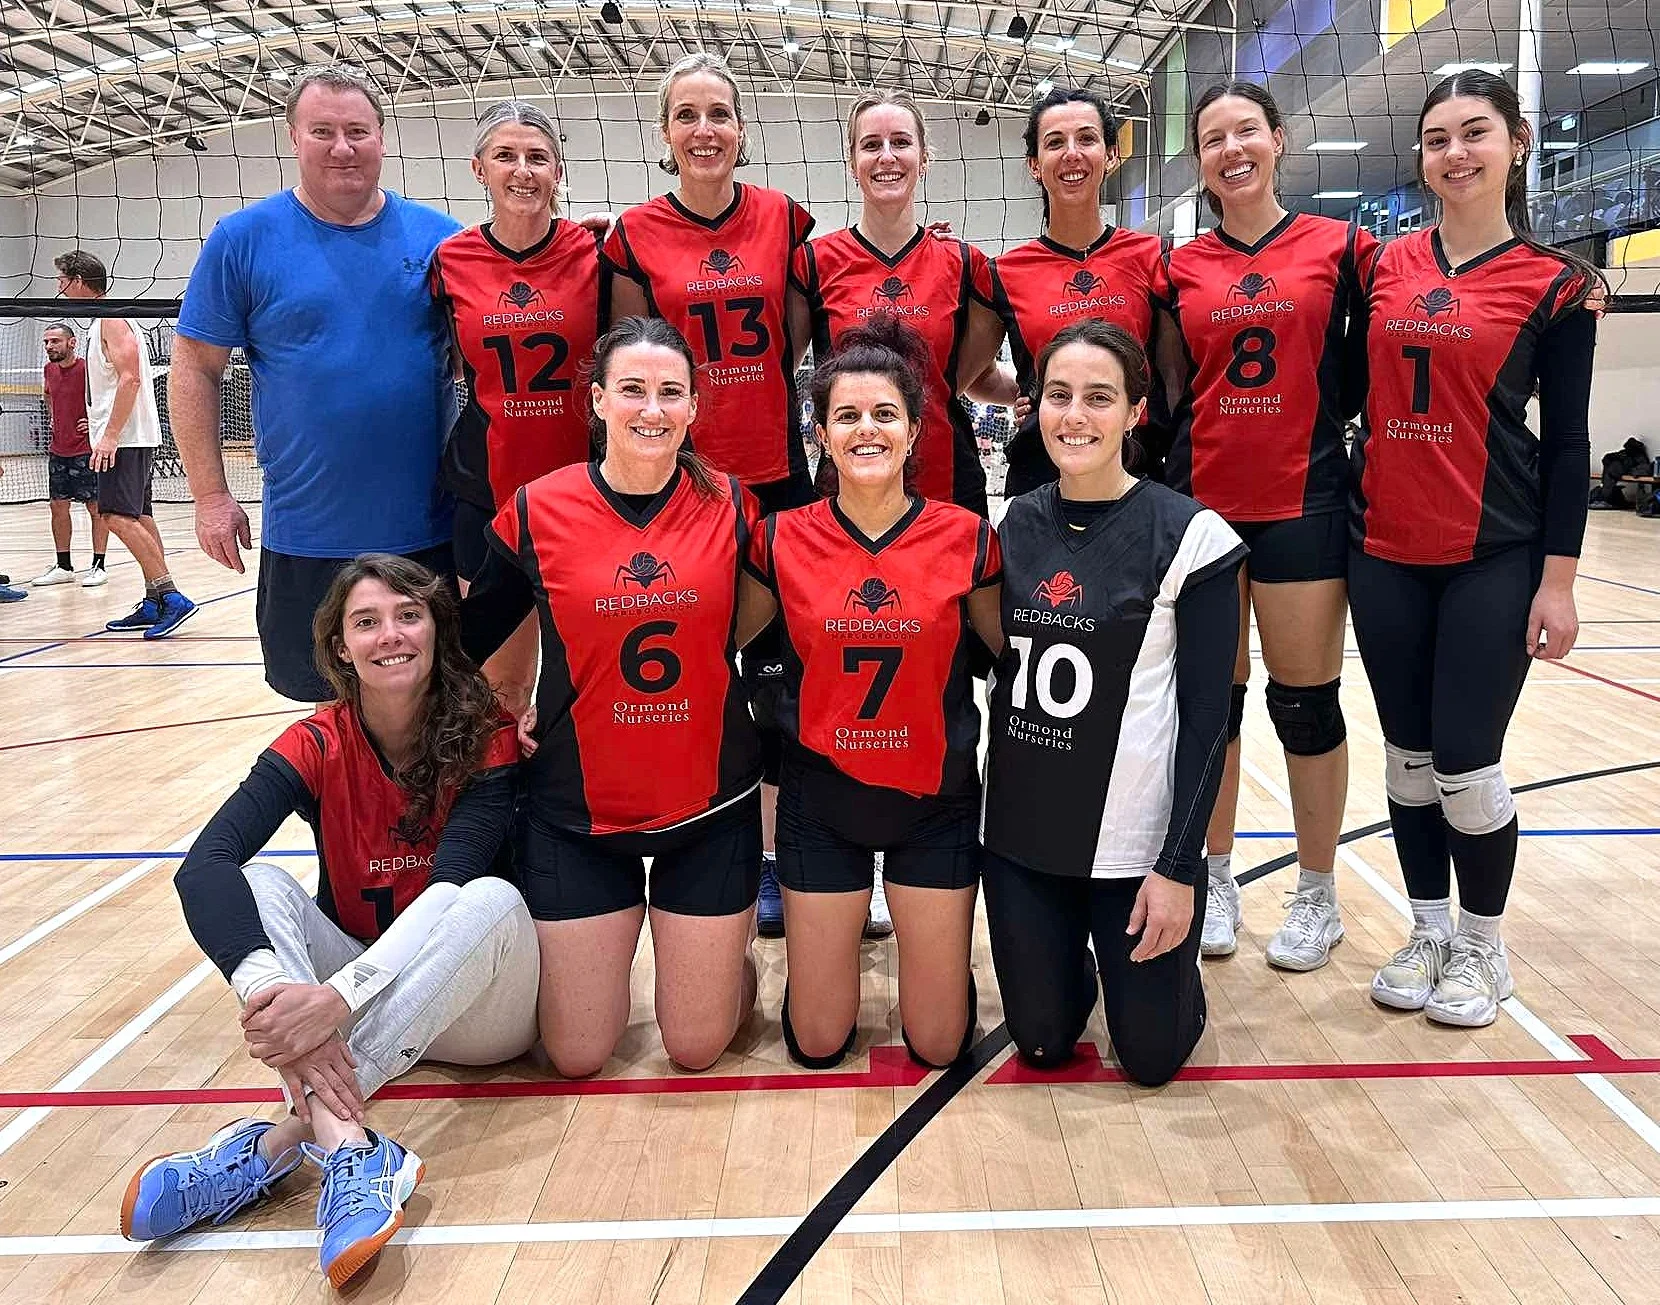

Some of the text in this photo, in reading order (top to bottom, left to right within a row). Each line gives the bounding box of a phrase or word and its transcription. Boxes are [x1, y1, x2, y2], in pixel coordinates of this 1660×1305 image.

[686, 275, 763, 292] REDBACKS
[1049, 295, 1126, 315] REDBACKS
[1211, 300, 1294, 322] REDBACKS
[483, 310, 565, 326] REDBACKS
[687, 297, 770, 363] 13
[1385, 319, 1473, 339] REDBACKS
[483, 333, 571, 394] 12
[1225, 326, 1276, 390] 8
[709, 363, 764, 377] Ormond
[709, 374, 764, 387] Nurseries
[1402, 345, 1431, 415] 1
[503, 396, 563, 409] Ormond
[1219, 393, 1281, 406] Ormond
[504, 406, 564, 418] Nurseries
[1219, 404, 1281, 415] Nurseries
[1386, 418, 1453, 433] Ormond
[1386, 428, 1453, 443] Nurseries
[595, 589, 699, 612] REDBACKS
[825, 619, 921, 633] REDBACKS
[1013, 608, 1096, 632] REDBACKS
[619, 620, 682, 694] 6
[842, 645, 904, 721] 7
[1008, 636, 1093, 718] 10
[613, 699, 689, 713] Ormond
[613, 711, 690, 724] Nurseries
[835, 725, 908, 738] Ormond
[1009, 715, 1073, 739] Ormond
[835, 737, 909, 750] Nurseries
[1007, 725, 1072, 750] Nurseries
[369, 854, 437, 873] REDBAC
